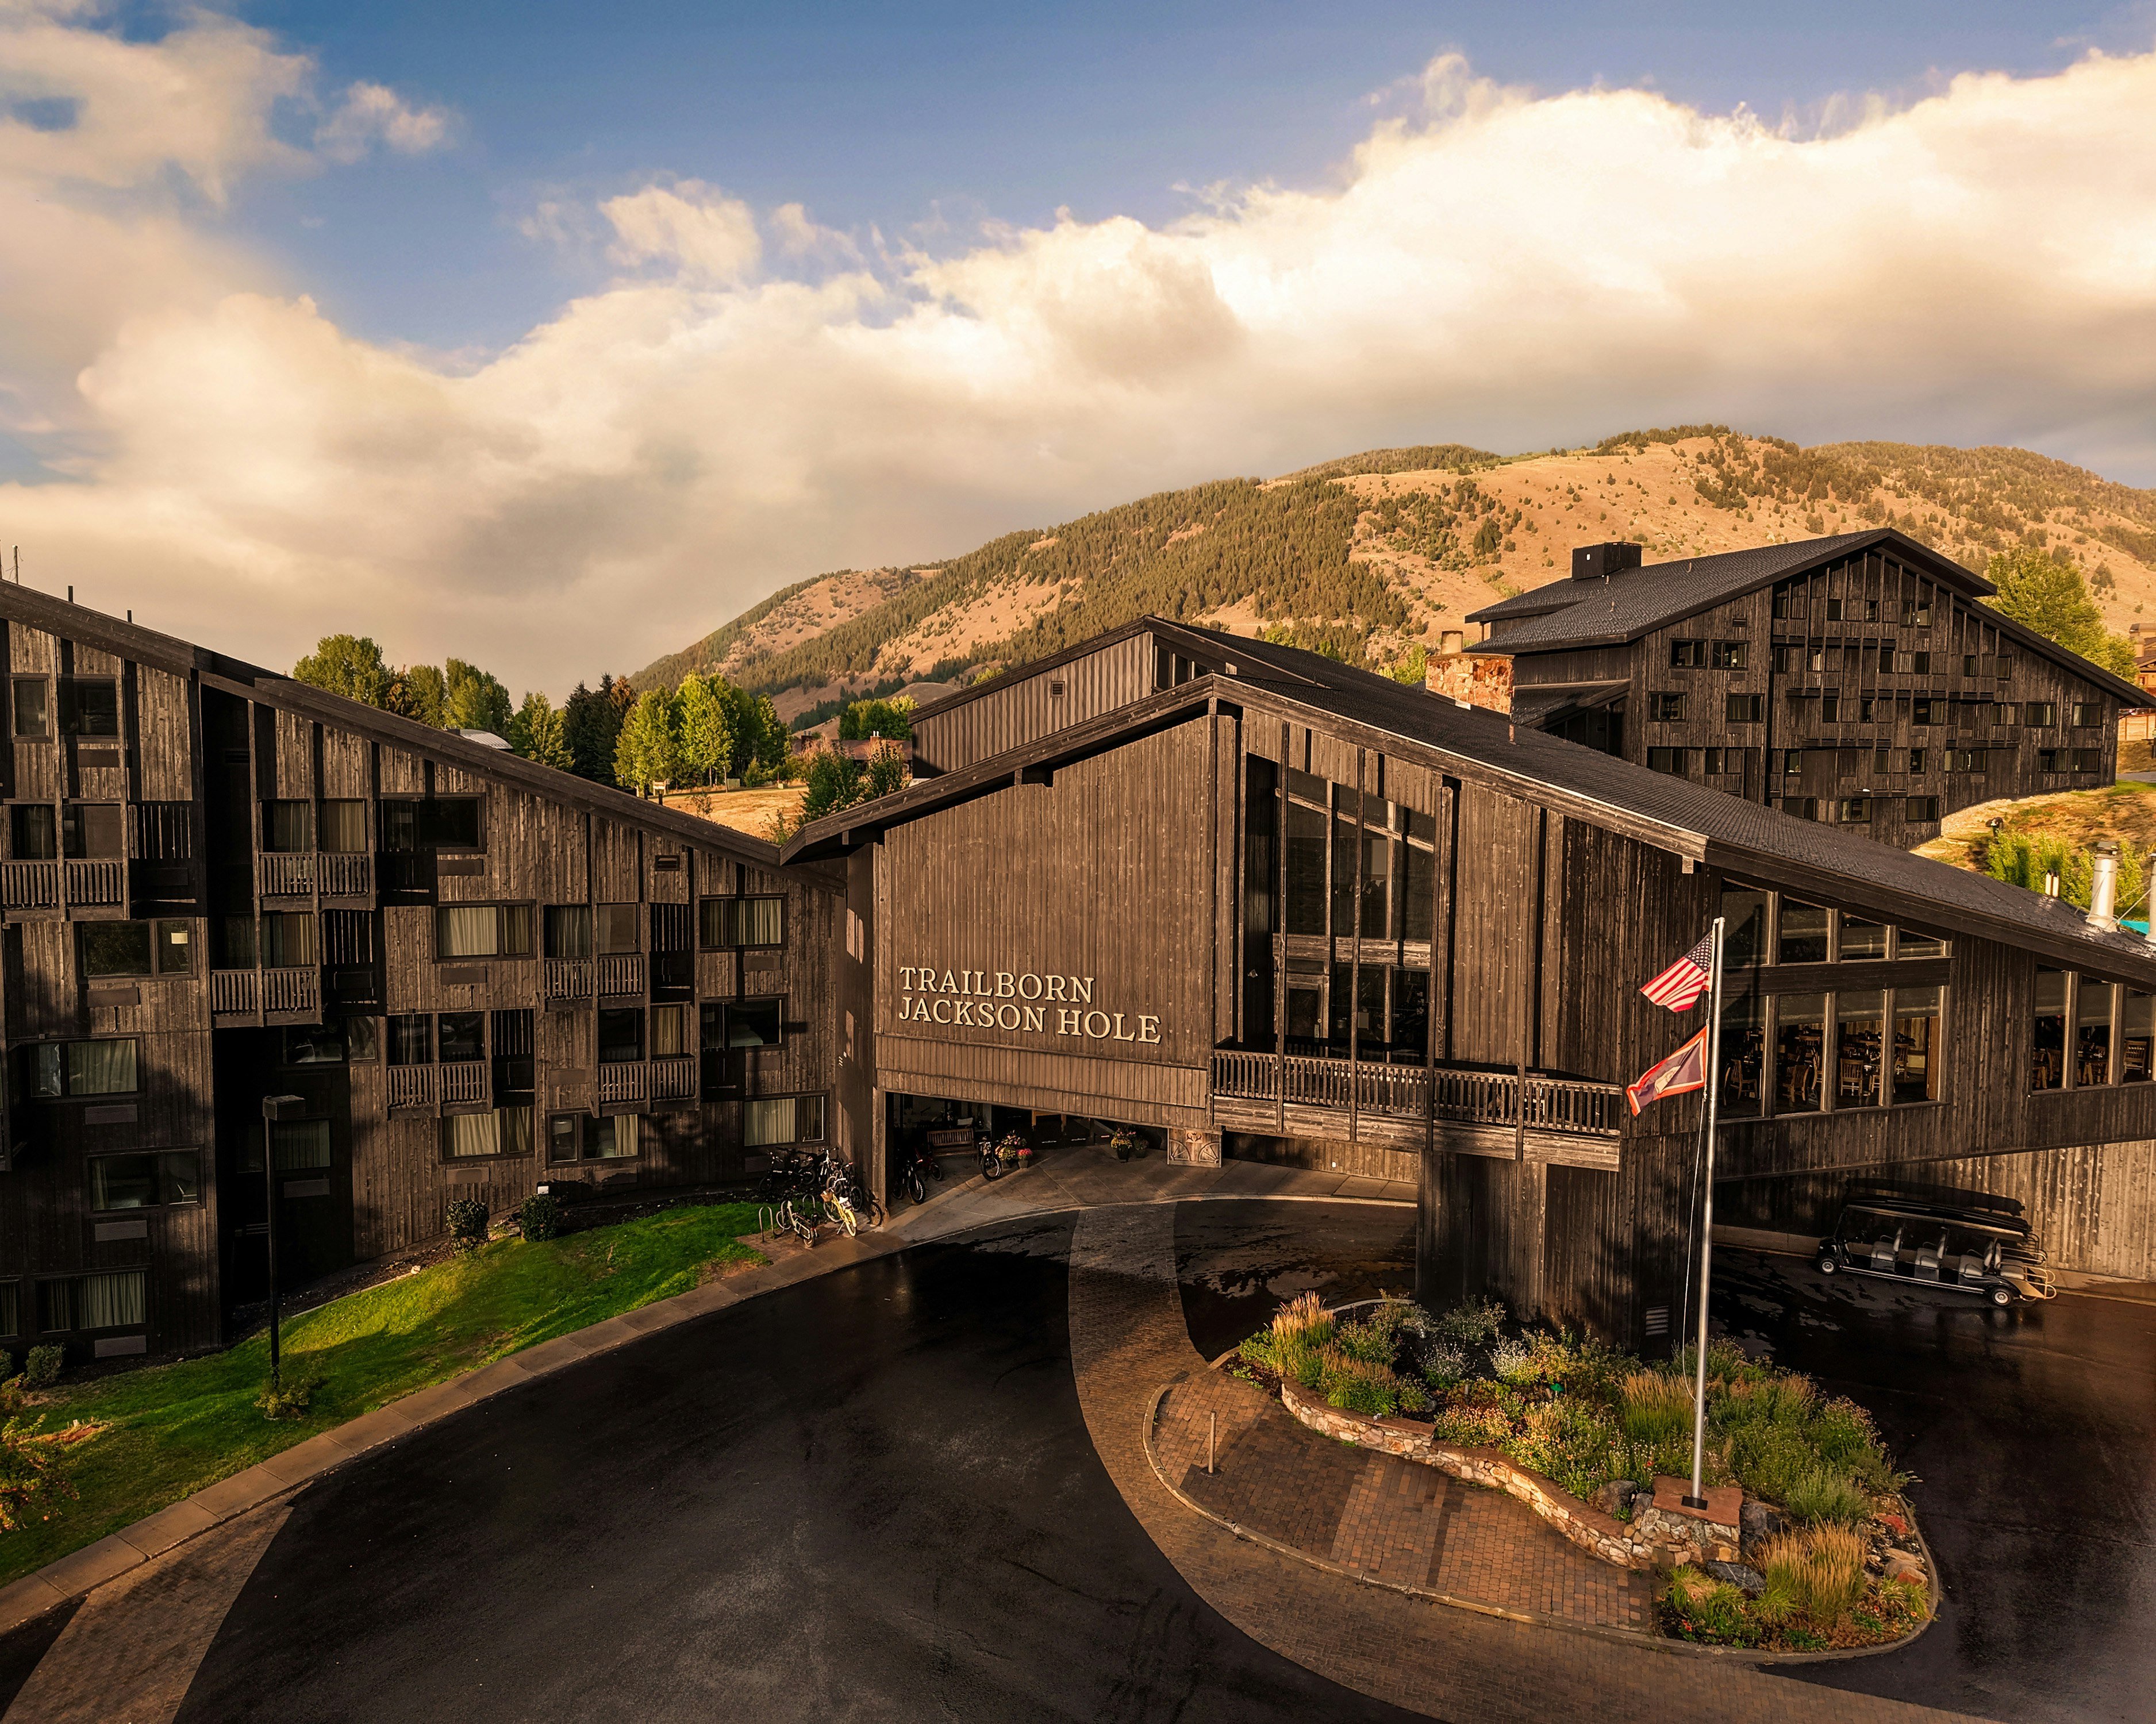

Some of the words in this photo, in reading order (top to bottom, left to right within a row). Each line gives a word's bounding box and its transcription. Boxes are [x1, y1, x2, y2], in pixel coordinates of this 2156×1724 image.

[900, 967, 1094, 1003] TRAILBORN
[899, 996, 1047, 1033] JACKSON
[1058, 1009, 1162, 1044] HOLE
